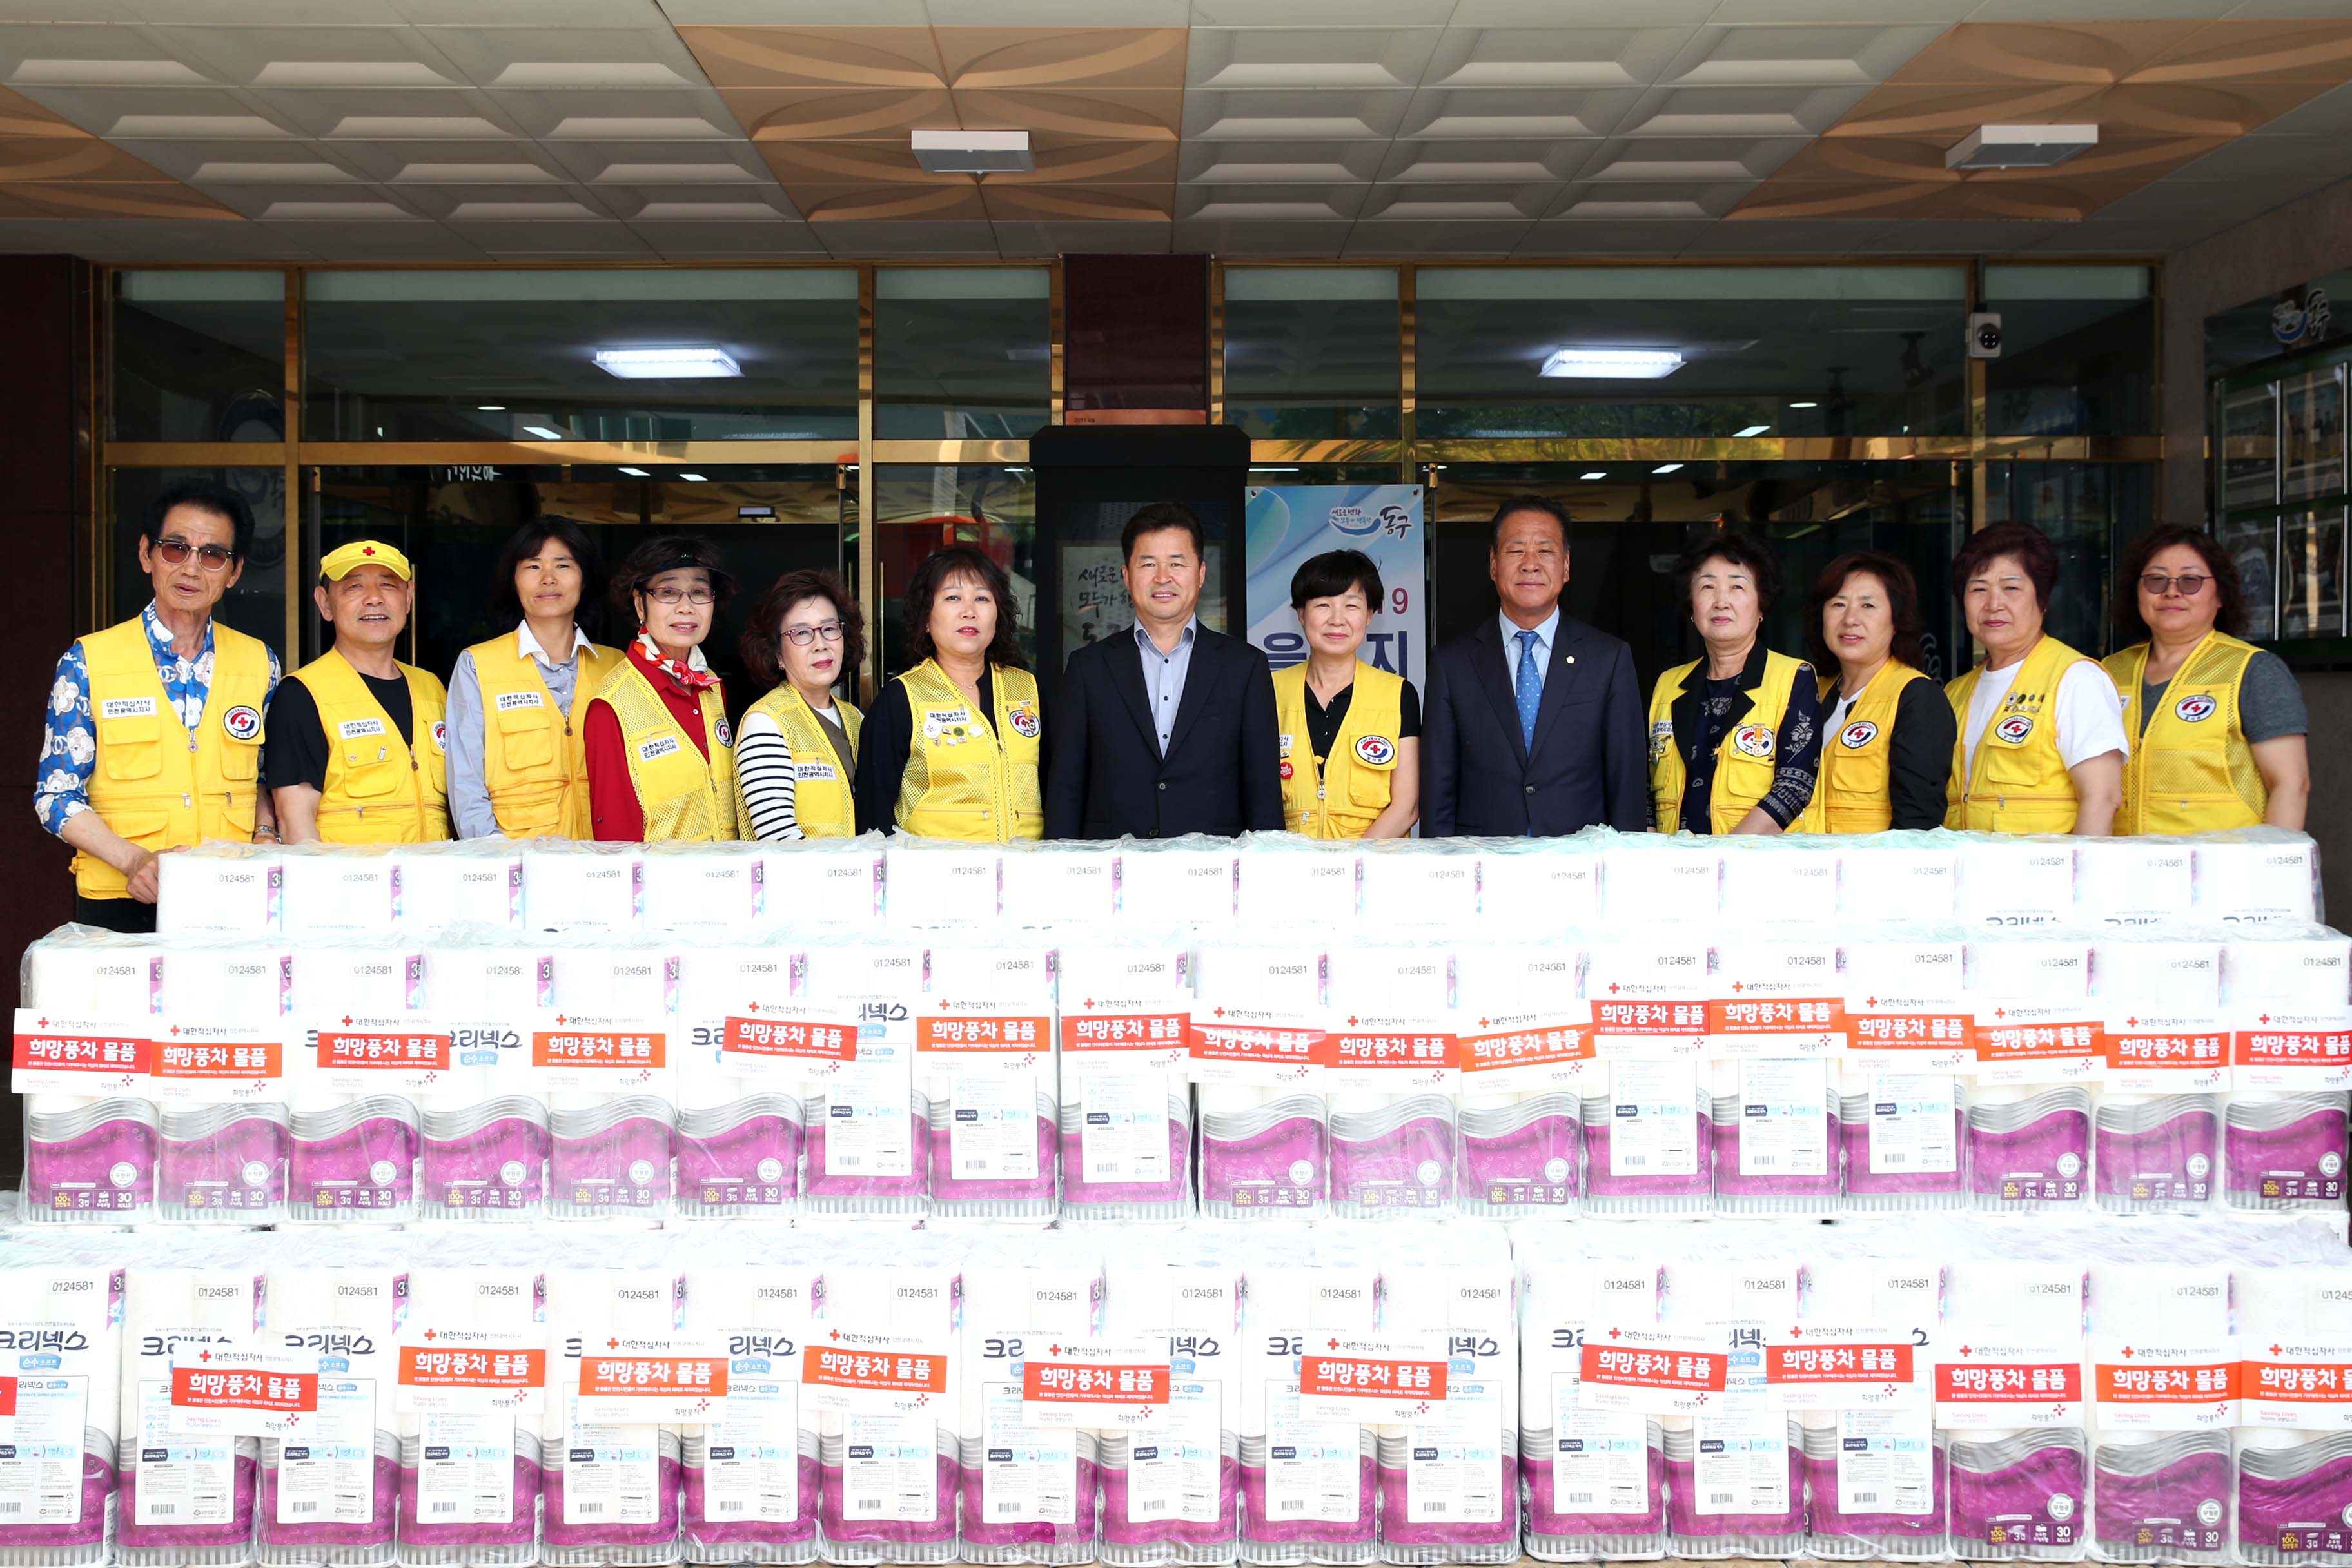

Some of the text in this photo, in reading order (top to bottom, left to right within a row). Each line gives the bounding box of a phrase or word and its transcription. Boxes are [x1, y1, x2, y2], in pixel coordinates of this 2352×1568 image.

[1380, 506, 1412, 539] 동구
[1078, 565, 1119, 587] 새로운
[1079, 591, 1118, 618] 모두가
[500, 693, 538, 702] 대한적십자사
[106, 700, 151, 709] 대한적십자사
[342, 720, 379, 729] 대한적십자사
[642, 738, 675, 753] 대한적십자사
[828, 868, 861, 877] 0124581
[1915, 954, 1952, 963] 0124581
[2304, 957, 2340, 966] 0124581
[97, 966, 135, 975] 0124581
[354, 966, 391, 974] 0124581
[741, 964, 777, 972] 0124581
[1128, 963, 1164, 972] 0124581
[1269, 966, 1306, 974] 0124581
[763, 1005, 805, 1014] 대한적십자사
[1601, 1004, 1704, 1024] 희망풍차 물품
[1724, 1003, 1831, 1024] 희망풍차 물품
[570, 1017, 611, 1025] 대한적십자사
[932, 1021, 1036, 1041] 희망풍차 물품
[1077, 1018, 1181, 1039] 희망풍차 물품
[1858, 1018, 1964, 1039] 희망풍차 물품
[739, 1023, 843, 1048] 희망풍차 물품
[1205, 1028, 1272, 1051] 희망풍차
[1990, 1026, 2092, 1050] 희망풍차 물품
[333, 1037, 438, 1058] 희망풍차 물품
[548, 1036, 652, 1057] 희망풍차 물품
[1340, 1037, 1445, 1057] 희망풍차 물품
[1473, 1030, 1581, 1058] 희망풍차 물품
[2119, 1038, 2188, 1058] 희망풍차
[2251, 1035, 2350, 1055] 희망풍차 물품
[30, 1039, 136, 1061] 희망풍차 물품
[163, 1046, 267, 1067] 희망풍차 물품
[117, 1193, 132, 1203] 30
[250, 1191, 264, 1202] 30
[53, 1281, 93, 1291] 0124581
[1604, 1280, 1644, 1289] 0124581
[2031, 1284, 2070, 1293] 0124581
[199, 1288, 238, 1297] 0124581
[338, 1286, 377, 1295] 0124581
[619, 1290, 658, 1299] 0124581
[898, 1288, 937, 1298] 0124581
[1321, 1289, 1360, 1298] 0124581
[440, 1331, 487, 1340] 대한적십자사
[843, 1333, 889, 1344] 대한적십자사
[1625, 1331, 1671, 1341] 대한적십자사
[623, 1340, 669, 1349] 대한적십자사
[729, 1335, 797, 1358] 리넥스
[215, 1353, 262, 1362] 대한적십자사
[1065, 1348, 1111, 1357] 대한적십자사
[1975, 1348, 2023, 1356] 대한적십자사
[23, 1357, 39, 1367] 순수
[415, 1352, 529, 1376] 희망풍차 물품
[820, 1351, 931, 1380] 희망풍차 물품
[1598, 1350, 1711, 1379] 희망풍차 물품
[1783, 1349, 1896, 1371] 희망풍차 물품
[734, 1361, 750, 1371] 순수
[596, 1361, 712, 1384] 희망풍차 물품
[1318, 1361, 1431, 1387] 희망풍차 물품
[1040, 1367, 1153, 1391] 희망풍차 물품
[1952, 1368, 2066, 1391] 희망풍차 물품
[2113, 1369, 2228, 1391] 희망풍차 물품
[2260, 1367, 2337, 1390] 희망풍차
[189, 1373, 301, 1399] 희망풍차 물품
[2057, 1526, 2071, 1537] 30
[2205, 1531, 2219, 1542] 30
